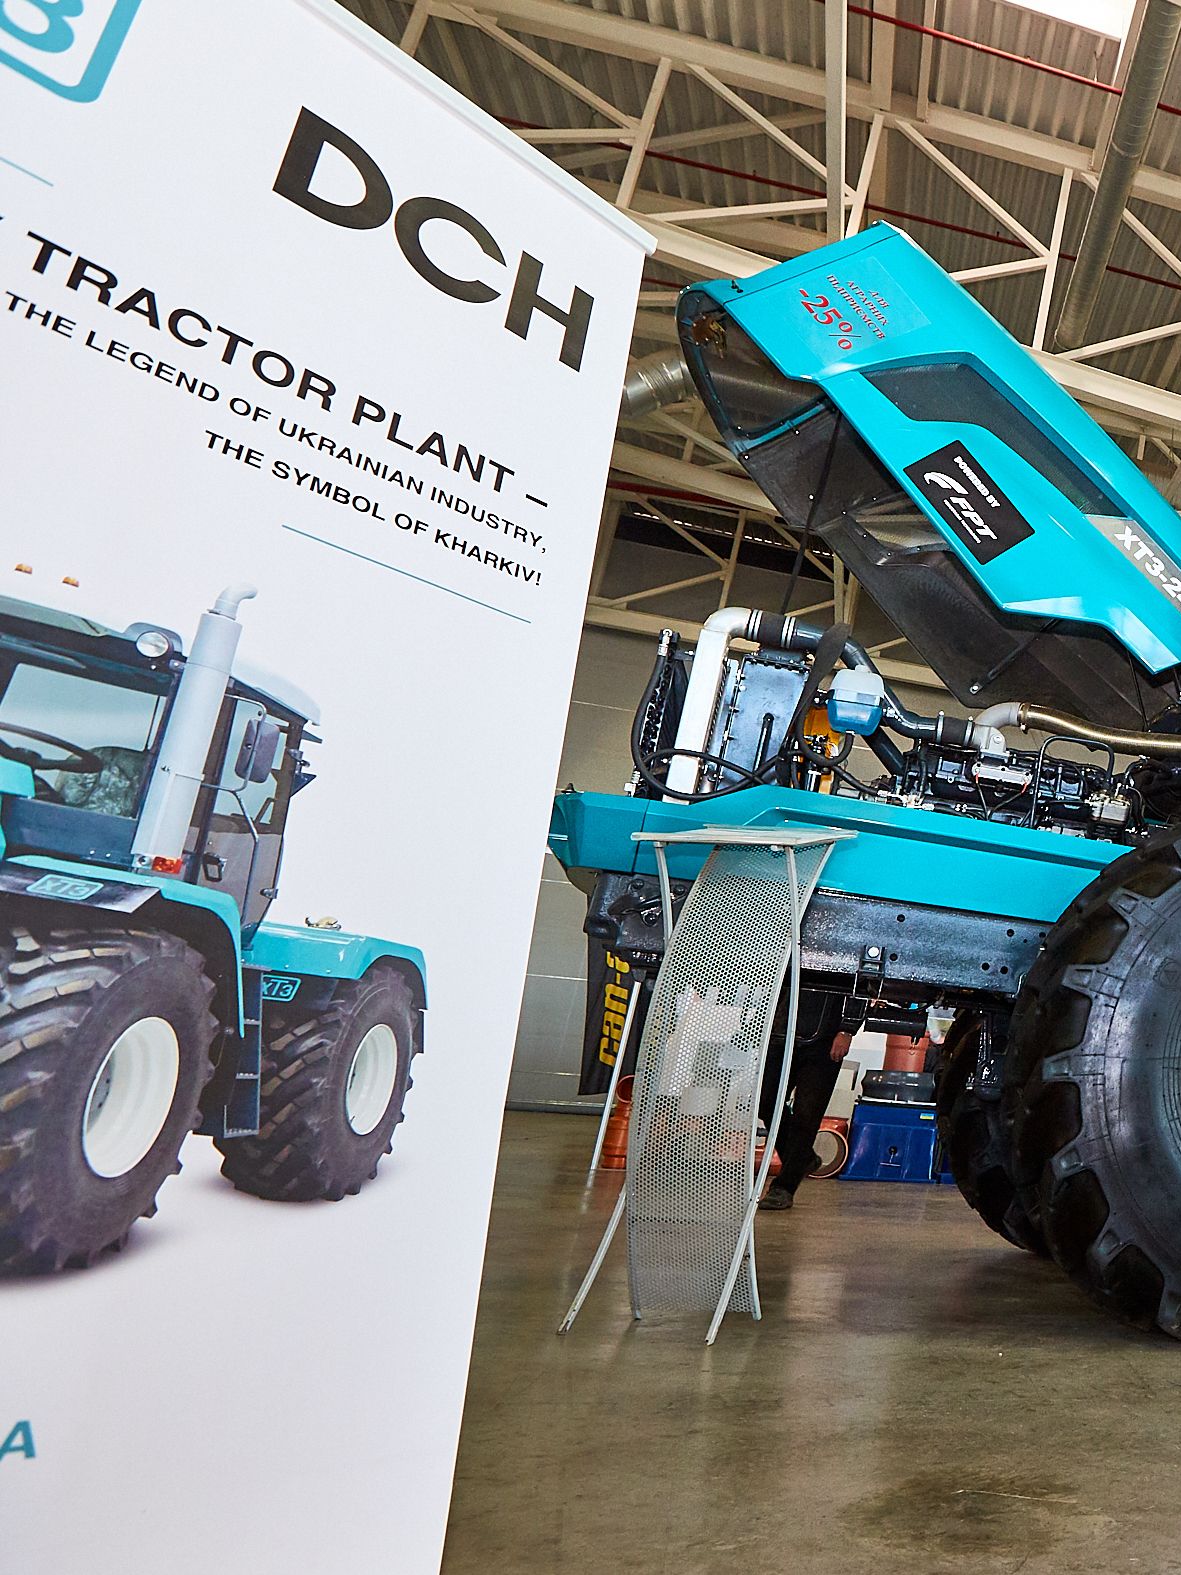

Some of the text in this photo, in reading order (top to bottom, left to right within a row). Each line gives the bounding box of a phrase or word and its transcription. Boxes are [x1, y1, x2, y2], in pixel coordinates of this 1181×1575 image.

[272, 106, 594, 372] DCH
[799, 288, 862, 350] -25%
[846, 280, 889, 326] АГРАРНИХ
[868, 289, 890, 309] ДЛЯ
[27, 231, 337, 412] TRACTOR
[352, 395, 516, 492] PLANT
[5, 290, 548, 554] THE LEGEND OF UKRAINIAN INDUSTRY,
[205, 430, 542, 587] THE SYMBOL OF KHARKIV!
[949, 496, 998, 540] FPT
